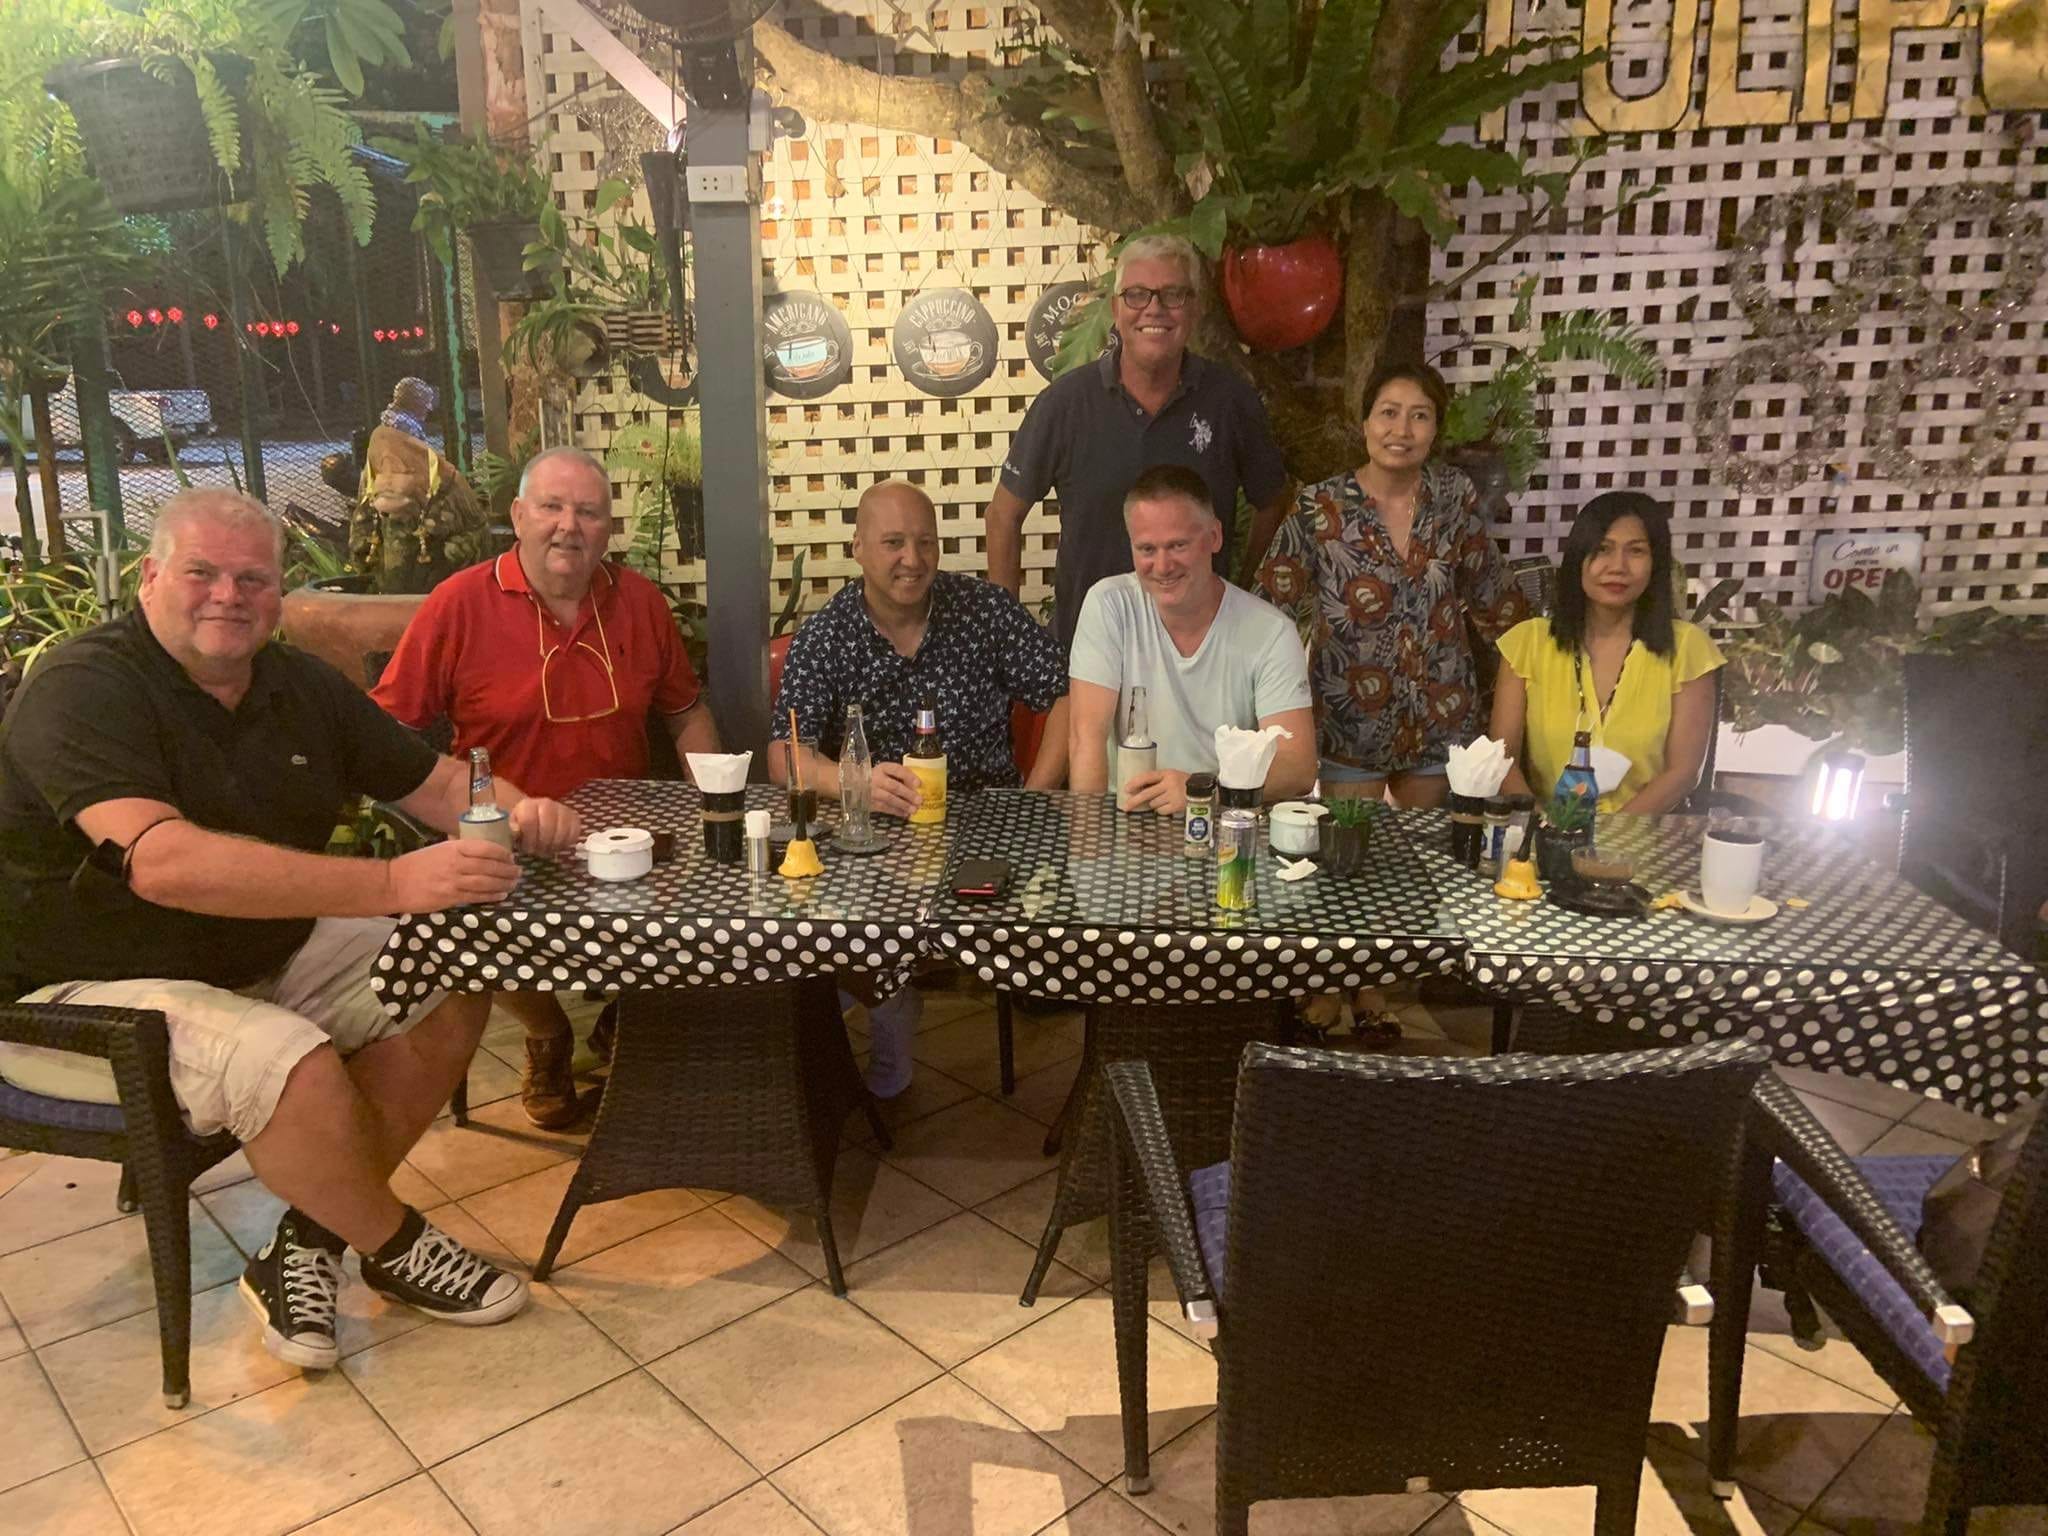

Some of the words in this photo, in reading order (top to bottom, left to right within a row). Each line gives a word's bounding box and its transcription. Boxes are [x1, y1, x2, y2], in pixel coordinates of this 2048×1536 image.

[764, 303, 829, 335] AMERICANO
[908, 296, 977, 329] CAPPUCCINO
[1823, 567, 1894, 589] OPE
